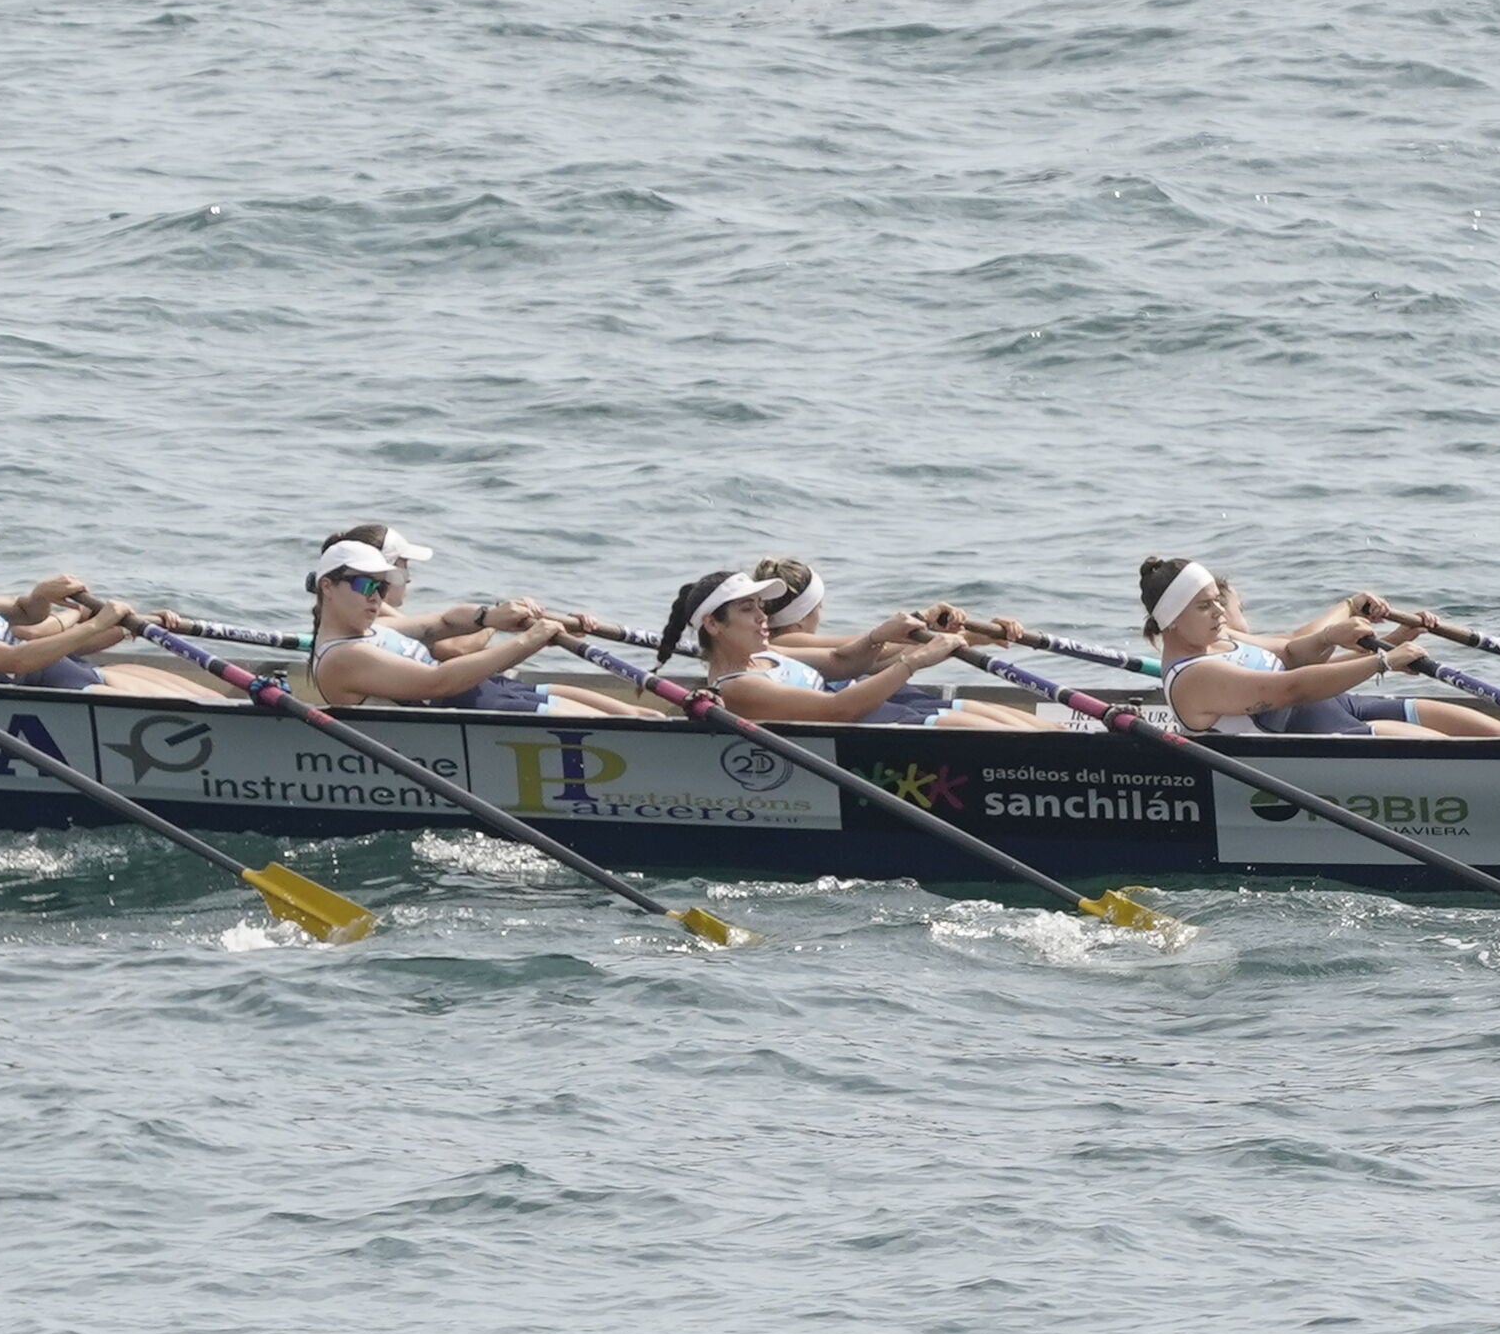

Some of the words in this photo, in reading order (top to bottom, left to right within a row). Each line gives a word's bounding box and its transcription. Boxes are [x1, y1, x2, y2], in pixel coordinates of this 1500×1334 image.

[982, 763, 1070, 785] gasóleos
[1075, 767, 1106, 783] del
[1112, 770, 1195, 788] morrazo
[984, 788, 1201, 824] sanchilán
